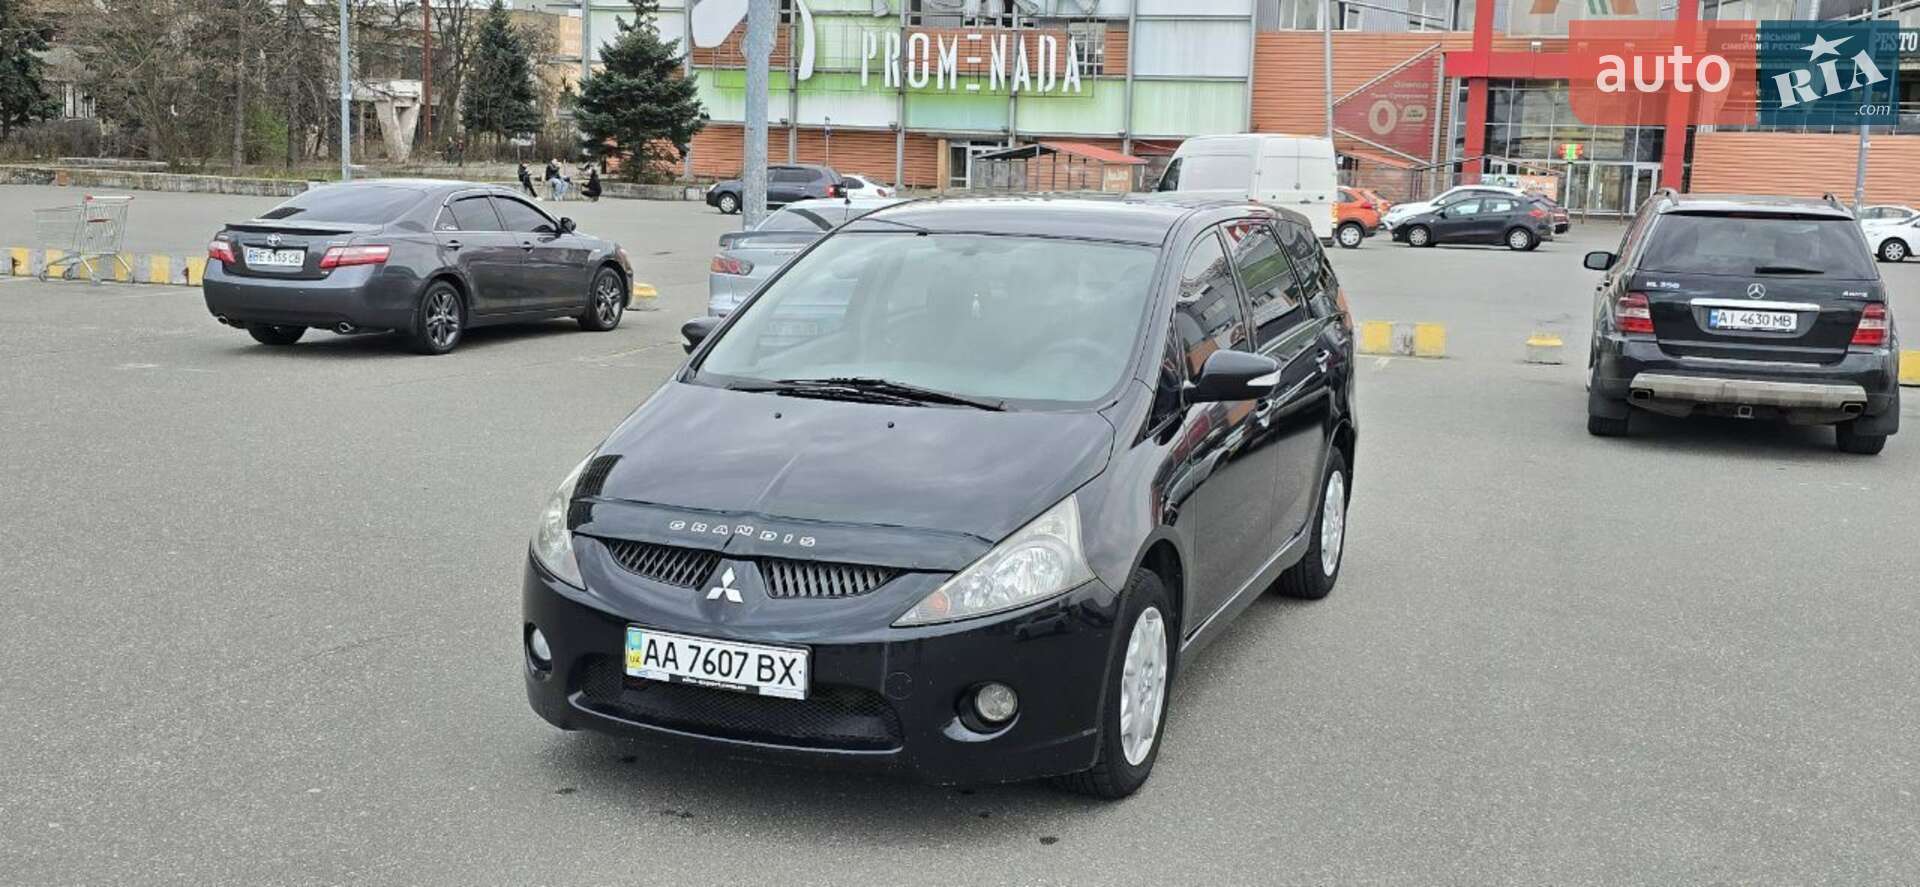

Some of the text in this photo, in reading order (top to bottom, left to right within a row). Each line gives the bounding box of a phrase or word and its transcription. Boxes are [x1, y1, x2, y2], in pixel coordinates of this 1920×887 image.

[861, 31, 1081, 93] PROMENADA
[1740, 312, 1770, 326] 4630
[1772, 313, 1792, 327] MB
[669, 519, 815, 547] GRANDIS
[643, 638, 797, 686] AA 7607 BX
